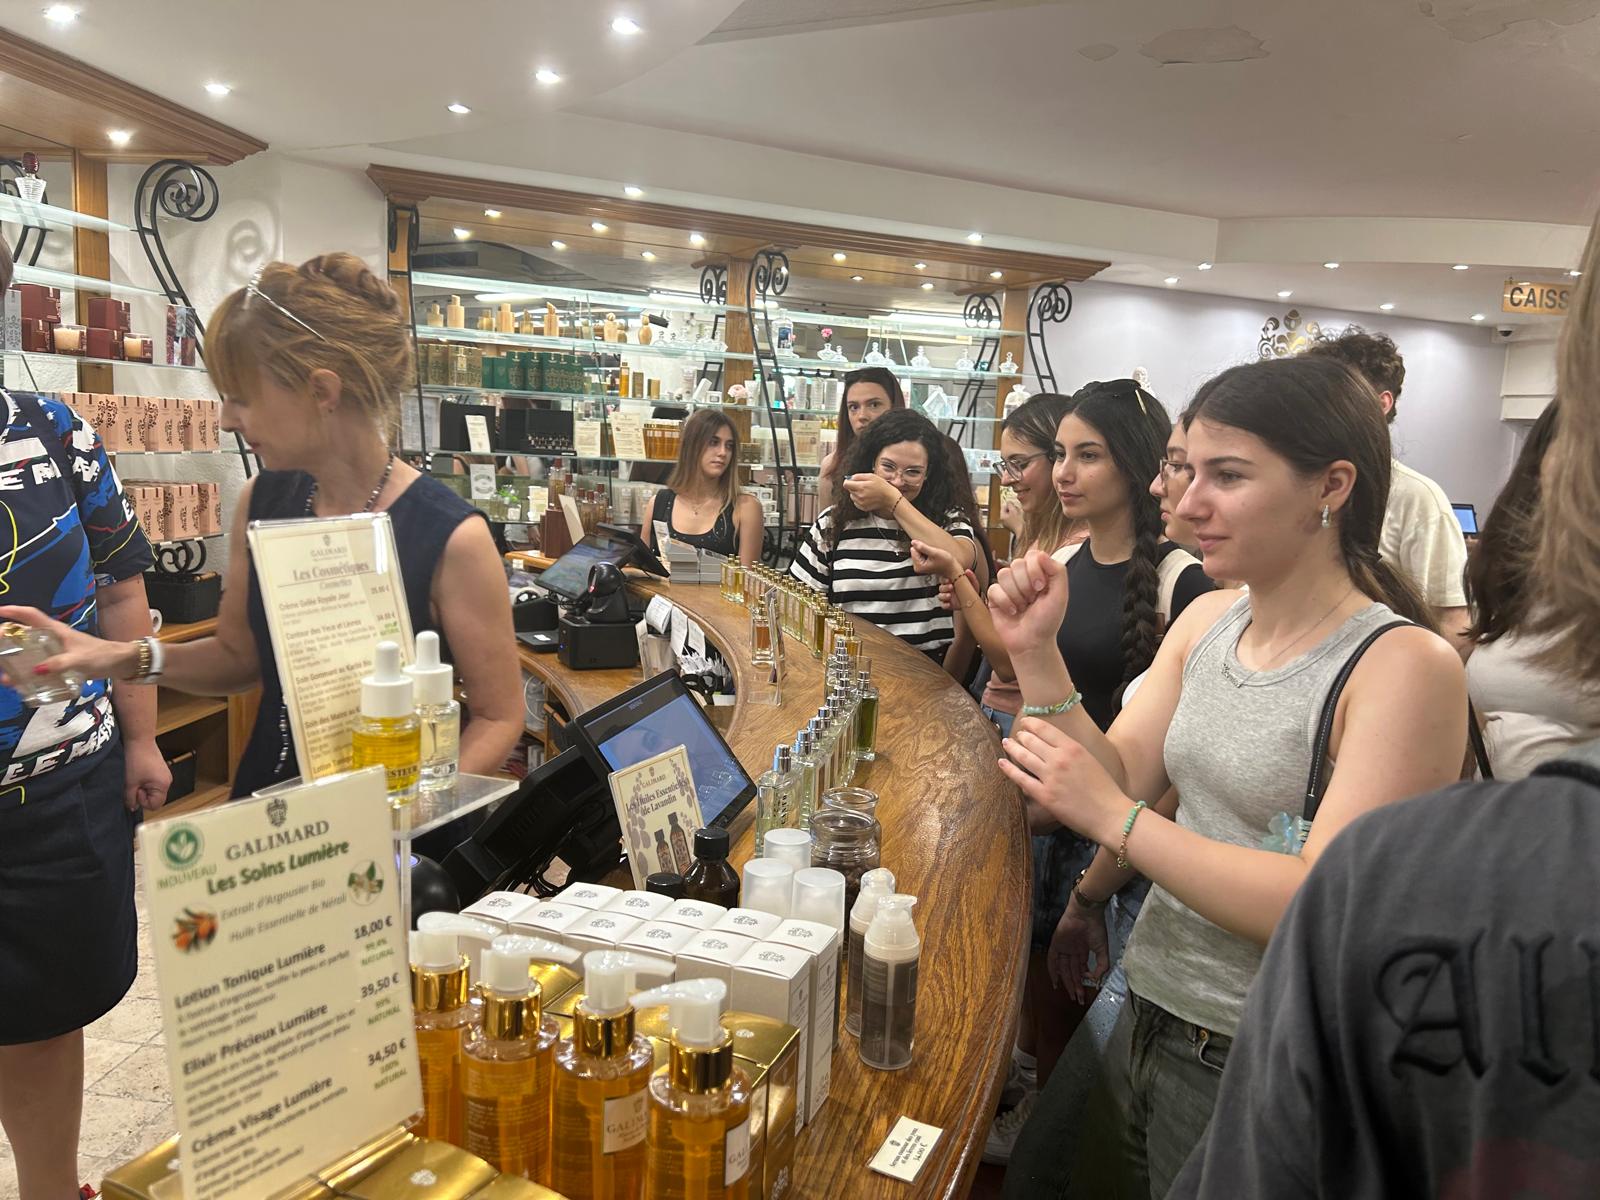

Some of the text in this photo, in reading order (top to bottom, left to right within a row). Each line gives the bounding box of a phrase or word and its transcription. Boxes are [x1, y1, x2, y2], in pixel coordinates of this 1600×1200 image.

[1509, 286, 1569, 310] CAISS
[293, 562, 370, 581] Les Cosmétiques
[641, 774, 666, 788] GALIMARD
[636, 791, 656, 806] Huiles
[651, 794, 677, 812] Lavandin
[225, 820, 330, 860] GALIMARD
[157, 863, 217, 890] NOUVEAU
[207, 840, 349, 895] Les Soins Lumière
[221, 901, 255, 921] Extrait
[311, 878, 326, 890] Bio
[230, 925, 256, 943] Huile
[257, 909, 306, 933] Essentielle
[308, 904, 319, 915] de
[354, 915, 393, 939] 18,00 €
[175, 943, 326, 1009] Lotion Tonique Lumière
[361, 972, 399, 999] 39,50 €
[368, 1004, 401, 1025] NATURAL
[182, 1004, 328, 1076] Elixir Précieux Lumière
[368, 1038, 406, 1066] 34,50 €
[374, 1068, 408, 1090] NATURAL
[191, 1125, 237, 1153] Crème
[239, 1102, 281, 1130] Visage
[283, 1077, 333, 1109] Lumière
